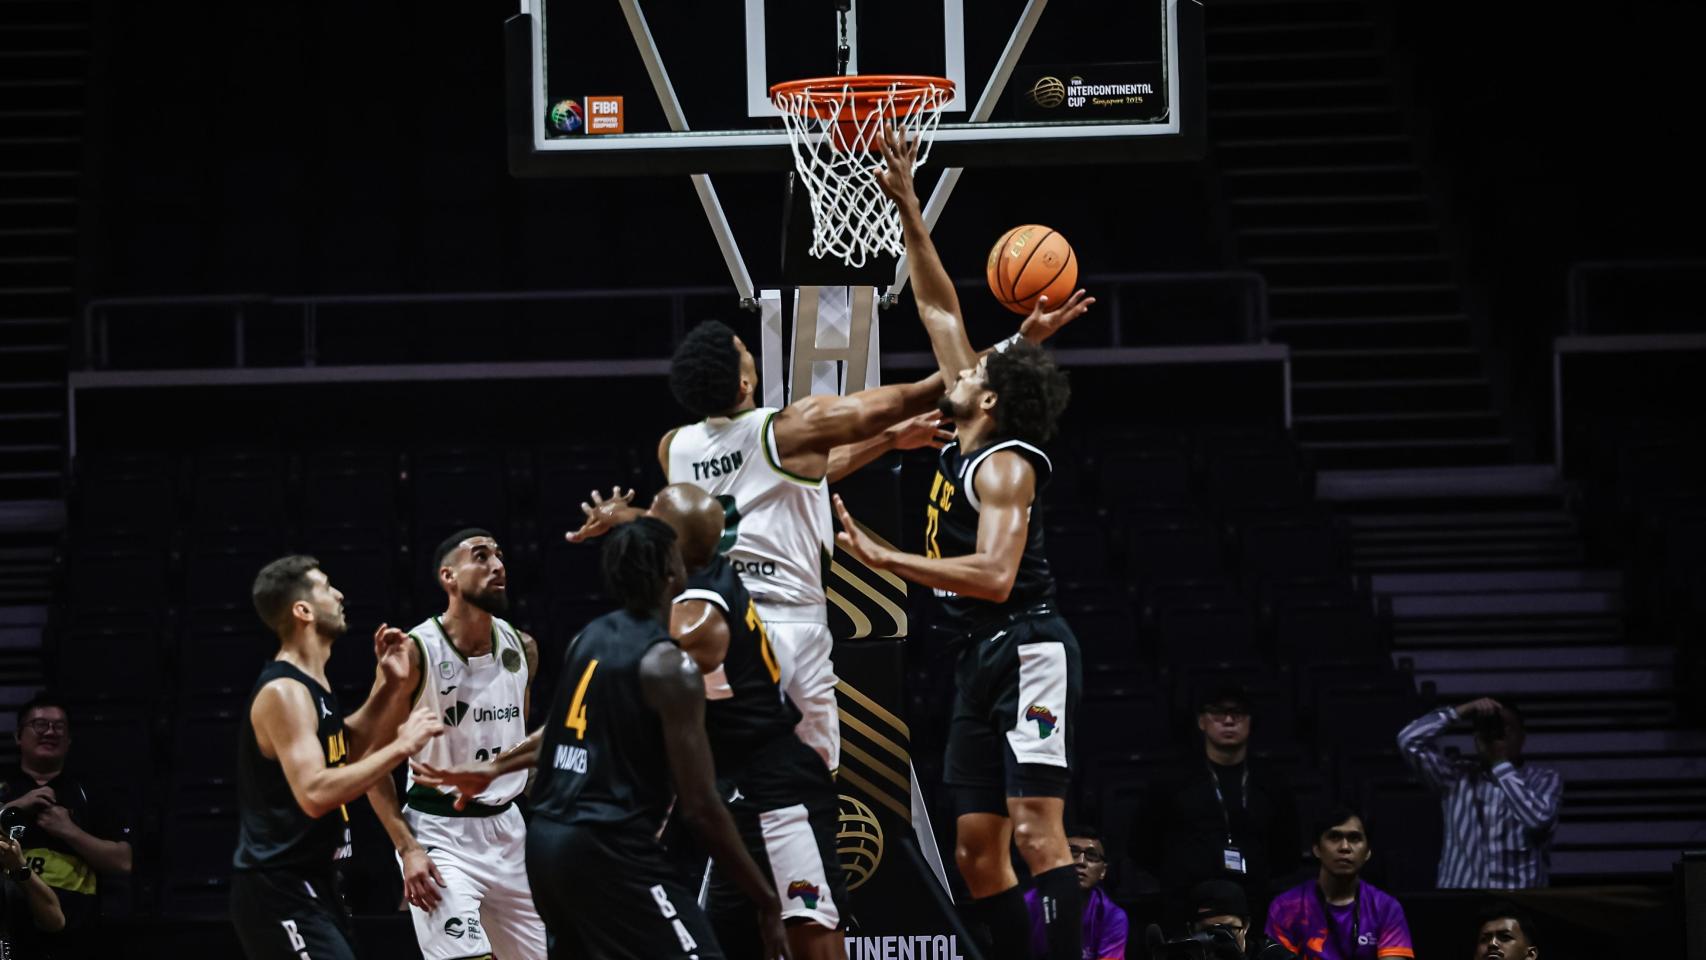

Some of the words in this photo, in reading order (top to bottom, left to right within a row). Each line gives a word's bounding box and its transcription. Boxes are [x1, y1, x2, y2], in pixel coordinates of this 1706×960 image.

[1067, 84, 1153, 96] INTERCONTINENTAL
[1067, 97, 1086, 107] CUP
[1126, 96, 1143, 104] 2025
[592, 101, 618, 114] FIBA
[693, 450, 743, 480] TYSON
[564, 659, 599, 740] 4
[473, 704, 519, 722] Unicaja
[649, 883, 699, 960] BA
[280, 919, 311, 960] B
